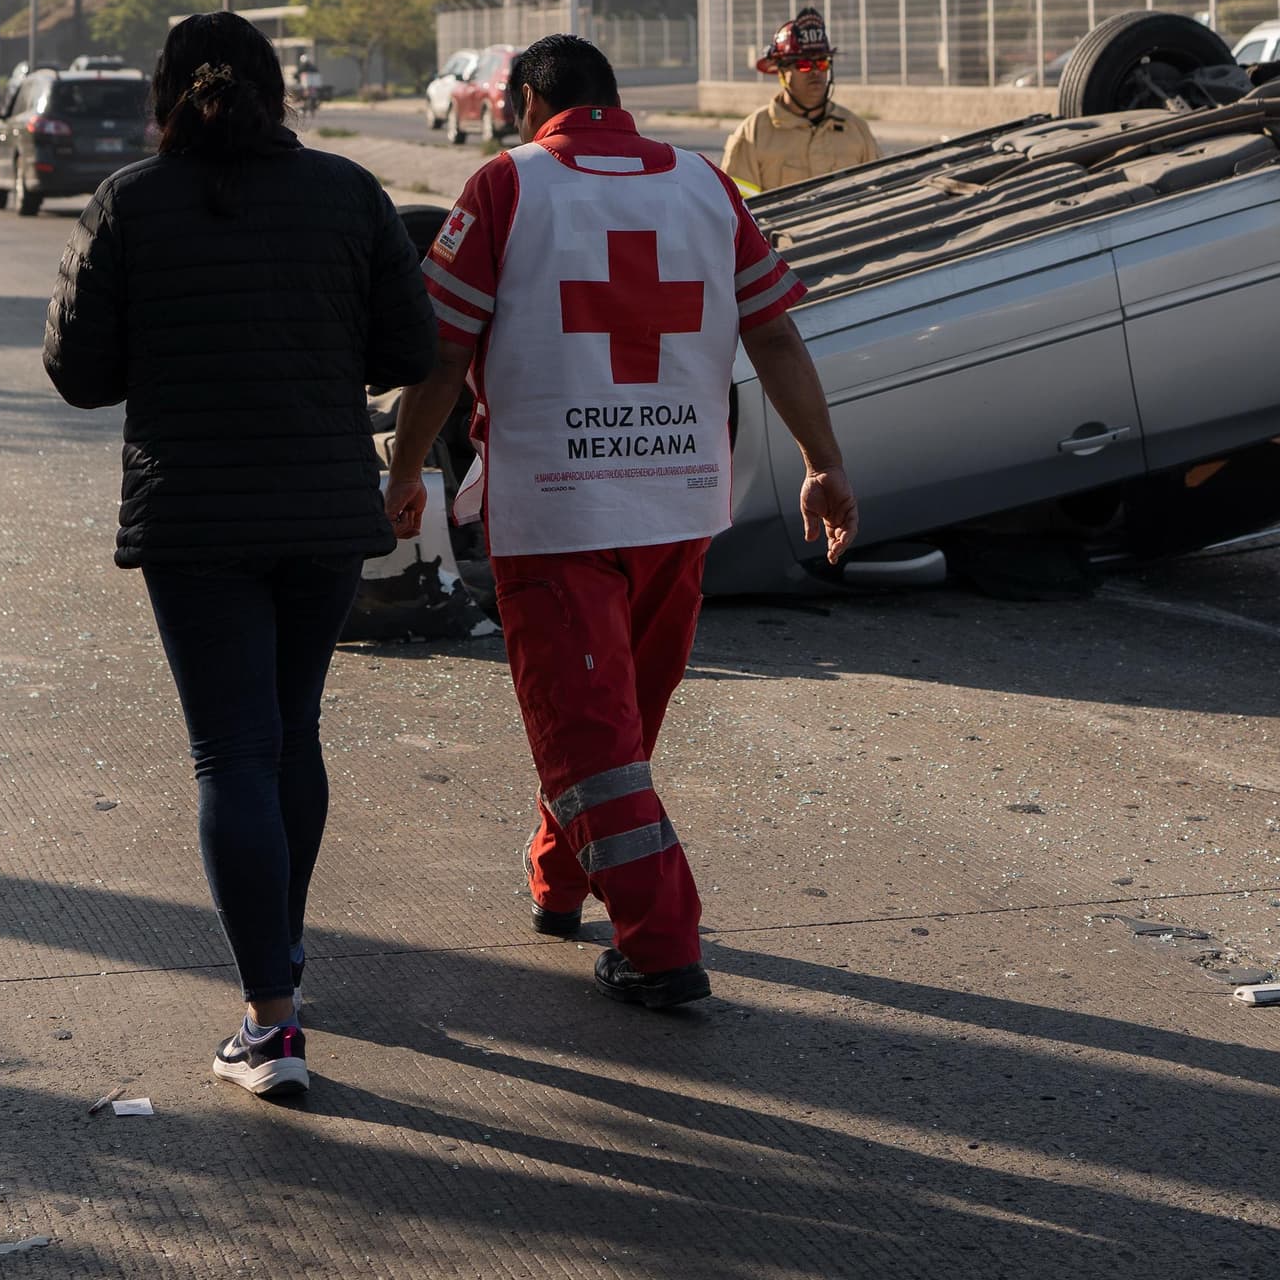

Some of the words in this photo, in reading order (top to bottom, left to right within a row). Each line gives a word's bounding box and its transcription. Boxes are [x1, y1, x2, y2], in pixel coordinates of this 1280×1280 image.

[799, 29, 823, 43] 307
[565, 406, 634, 429] CRUZ
[639, 404, 698, 427] ROJA
[567, 434, 696, 459] MEXICANA
